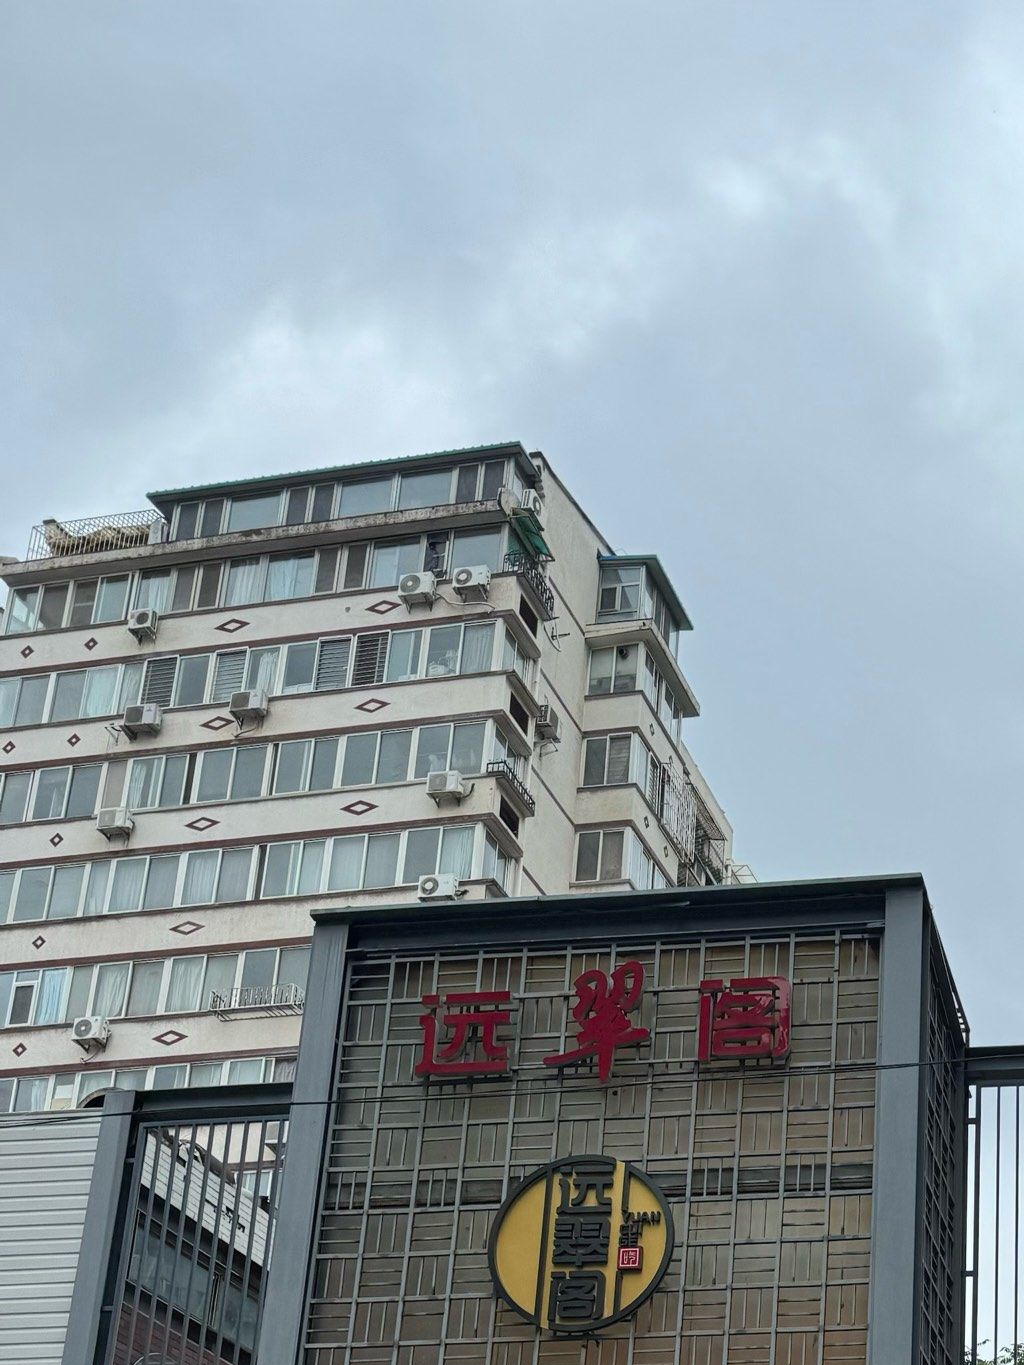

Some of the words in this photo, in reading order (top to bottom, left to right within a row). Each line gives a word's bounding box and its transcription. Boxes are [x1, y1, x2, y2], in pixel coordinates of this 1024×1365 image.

[415, 960, 792, 1083] 远翠阁
[548, 1164, 616, 1321] 远翠阁
